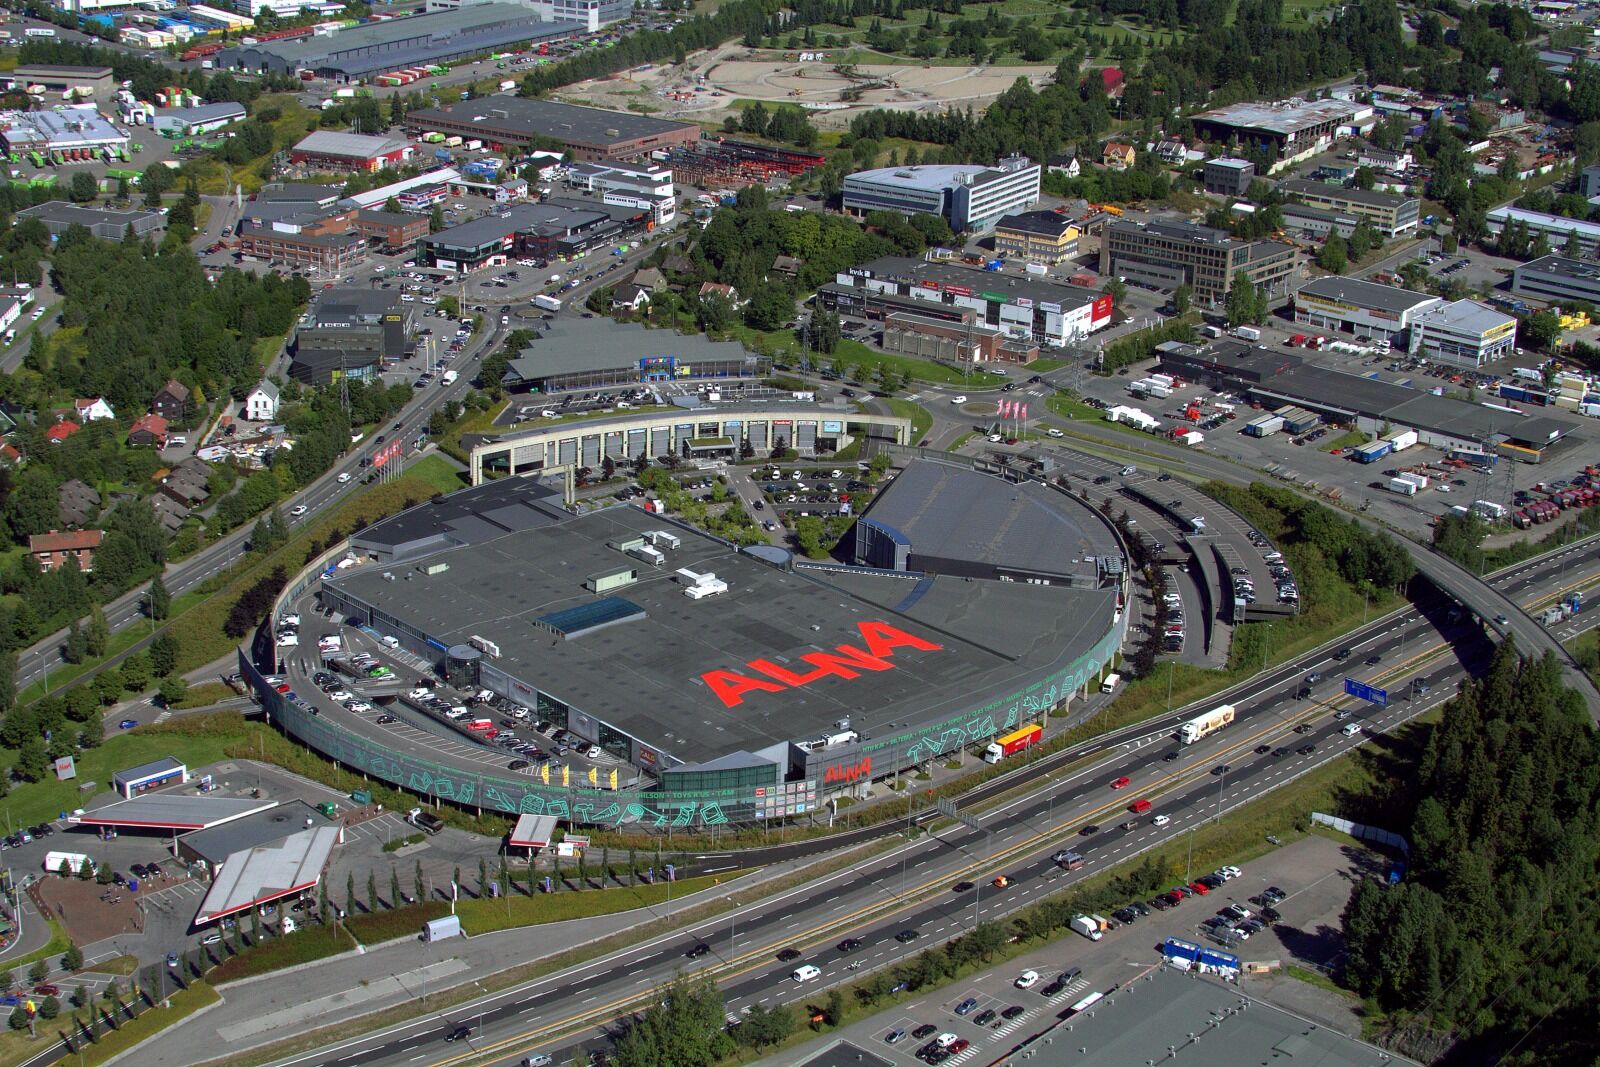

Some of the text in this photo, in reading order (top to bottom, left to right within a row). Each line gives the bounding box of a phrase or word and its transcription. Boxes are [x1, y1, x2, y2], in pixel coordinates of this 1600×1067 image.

[849, 267, 864, 277] kvik
[701, 622, 943, 708] ALNA
[636, 790, 665, 799] OHLSON
